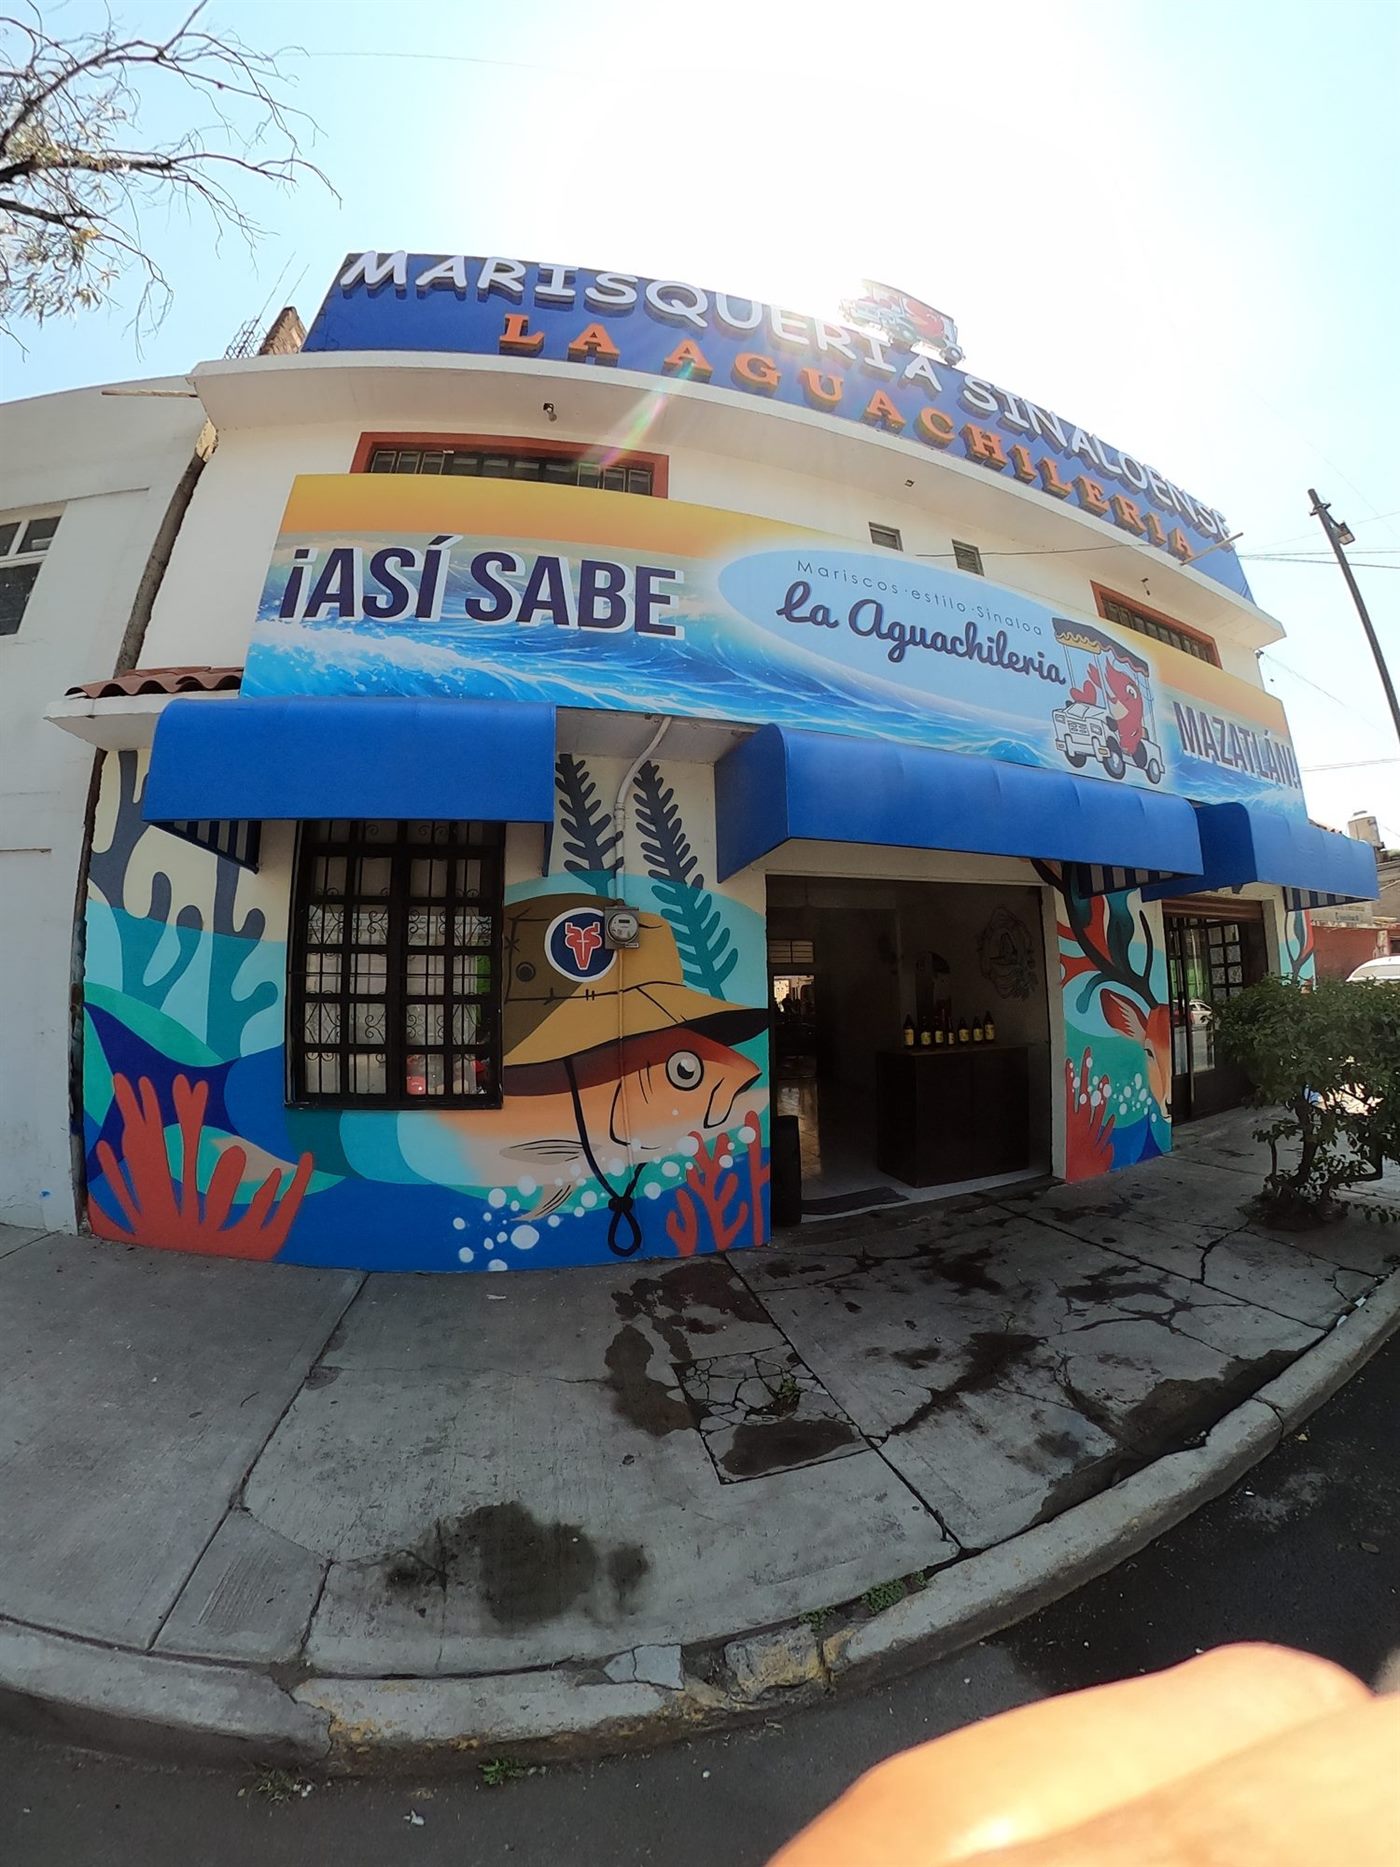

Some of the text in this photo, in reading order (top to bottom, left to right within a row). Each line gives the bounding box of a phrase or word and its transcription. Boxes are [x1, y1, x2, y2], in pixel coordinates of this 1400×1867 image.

[340, 250, 1232, 546] MARISQUERIA SINALOENSE
[499, 313, 1194, 562] LA AGUACHILERIA
[279, 534, 682, 638] ¡ASÍ SABE
[796, 560, 899, 595] Mariscos
[848, 598, 1066, 685] Aguachileria
[1172, 700, 1301, 789] MAZATLÁN!
